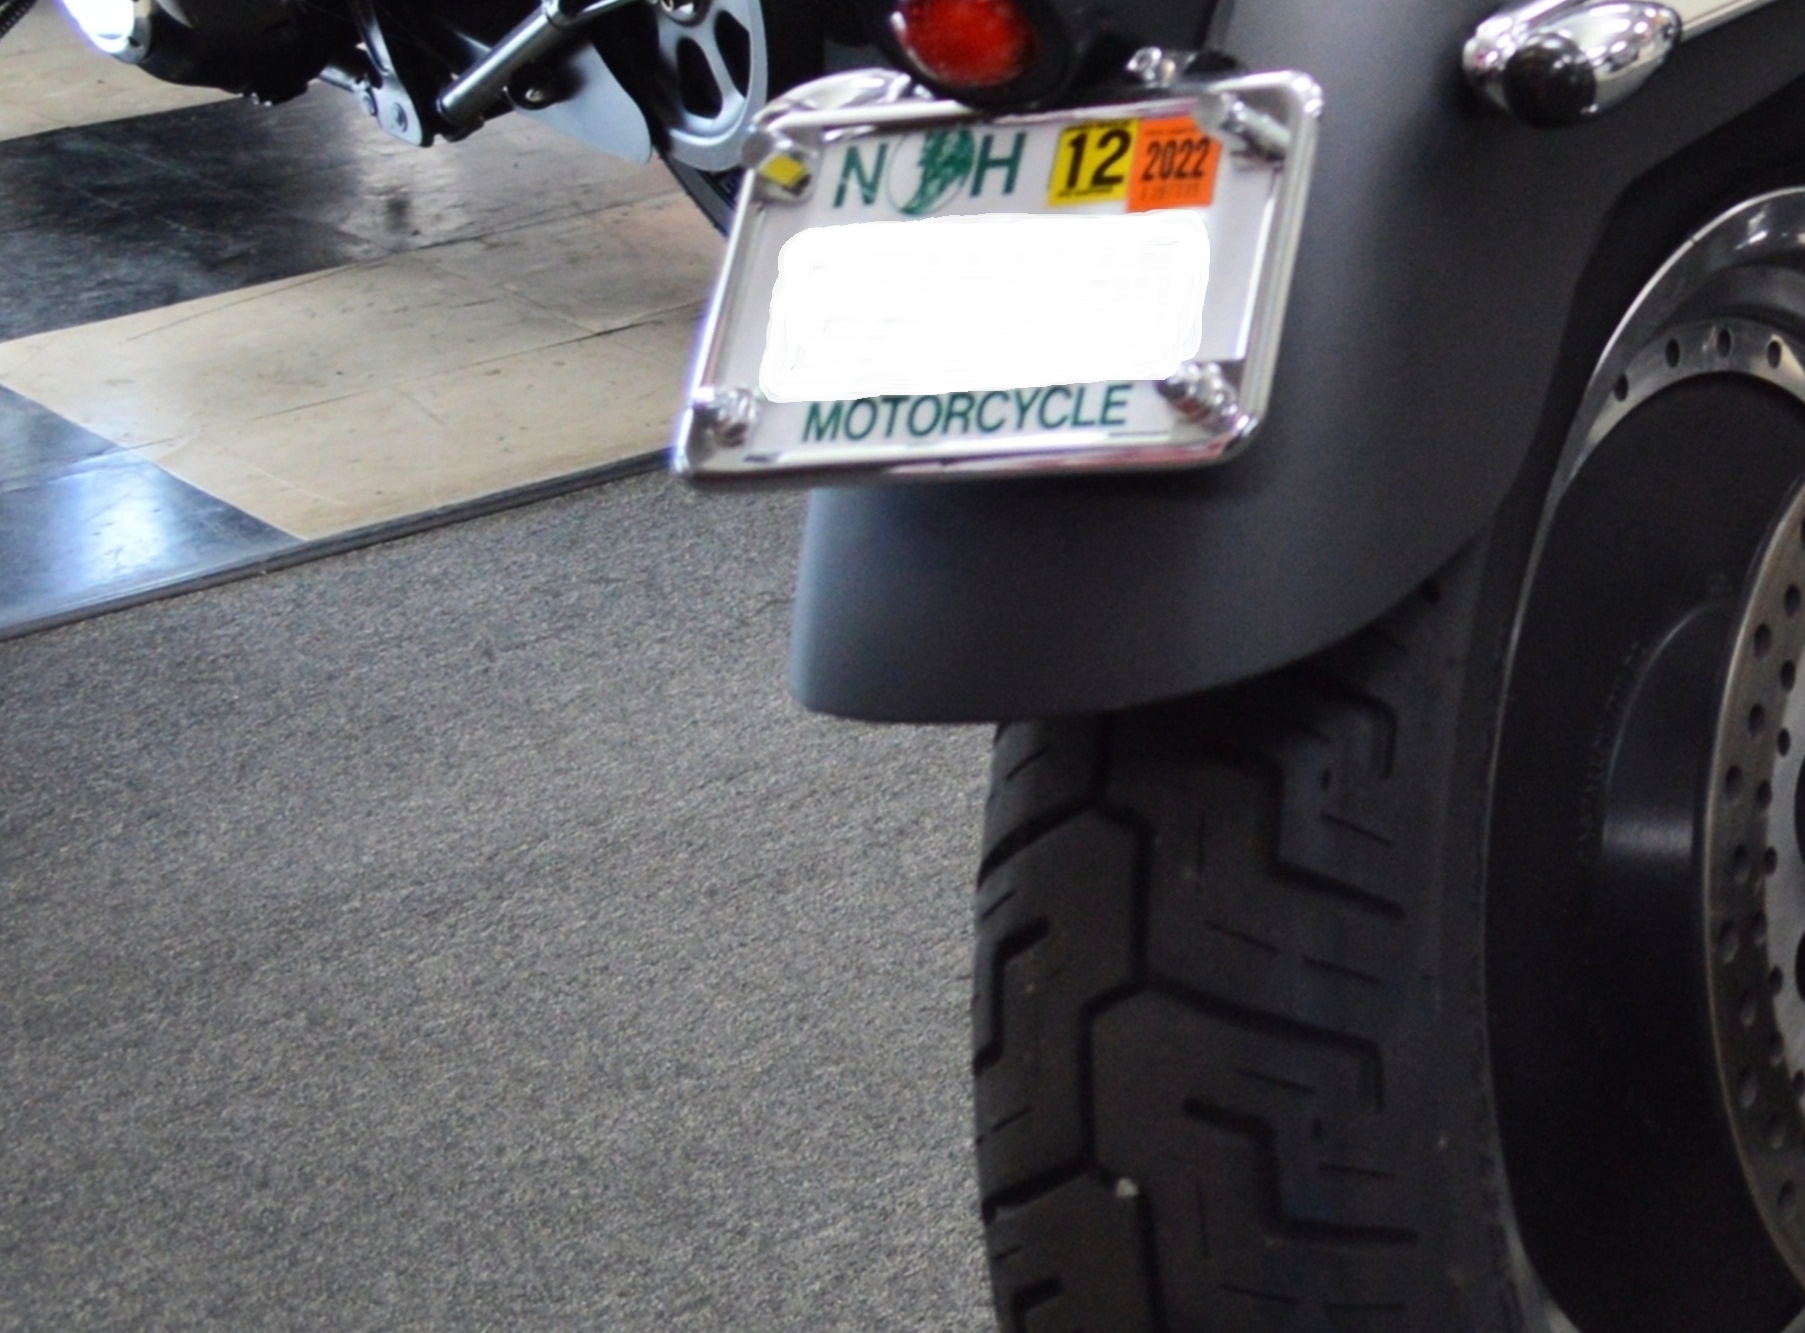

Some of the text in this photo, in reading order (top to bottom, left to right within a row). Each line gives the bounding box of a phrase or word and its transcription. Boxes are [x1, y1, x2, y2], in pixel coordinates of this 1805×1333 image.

[1065, 128, 1133, 190] 12
[1142, 135, 1212, 182] 2022
[802, 383, 1134, 443] MOTORCYCLE
